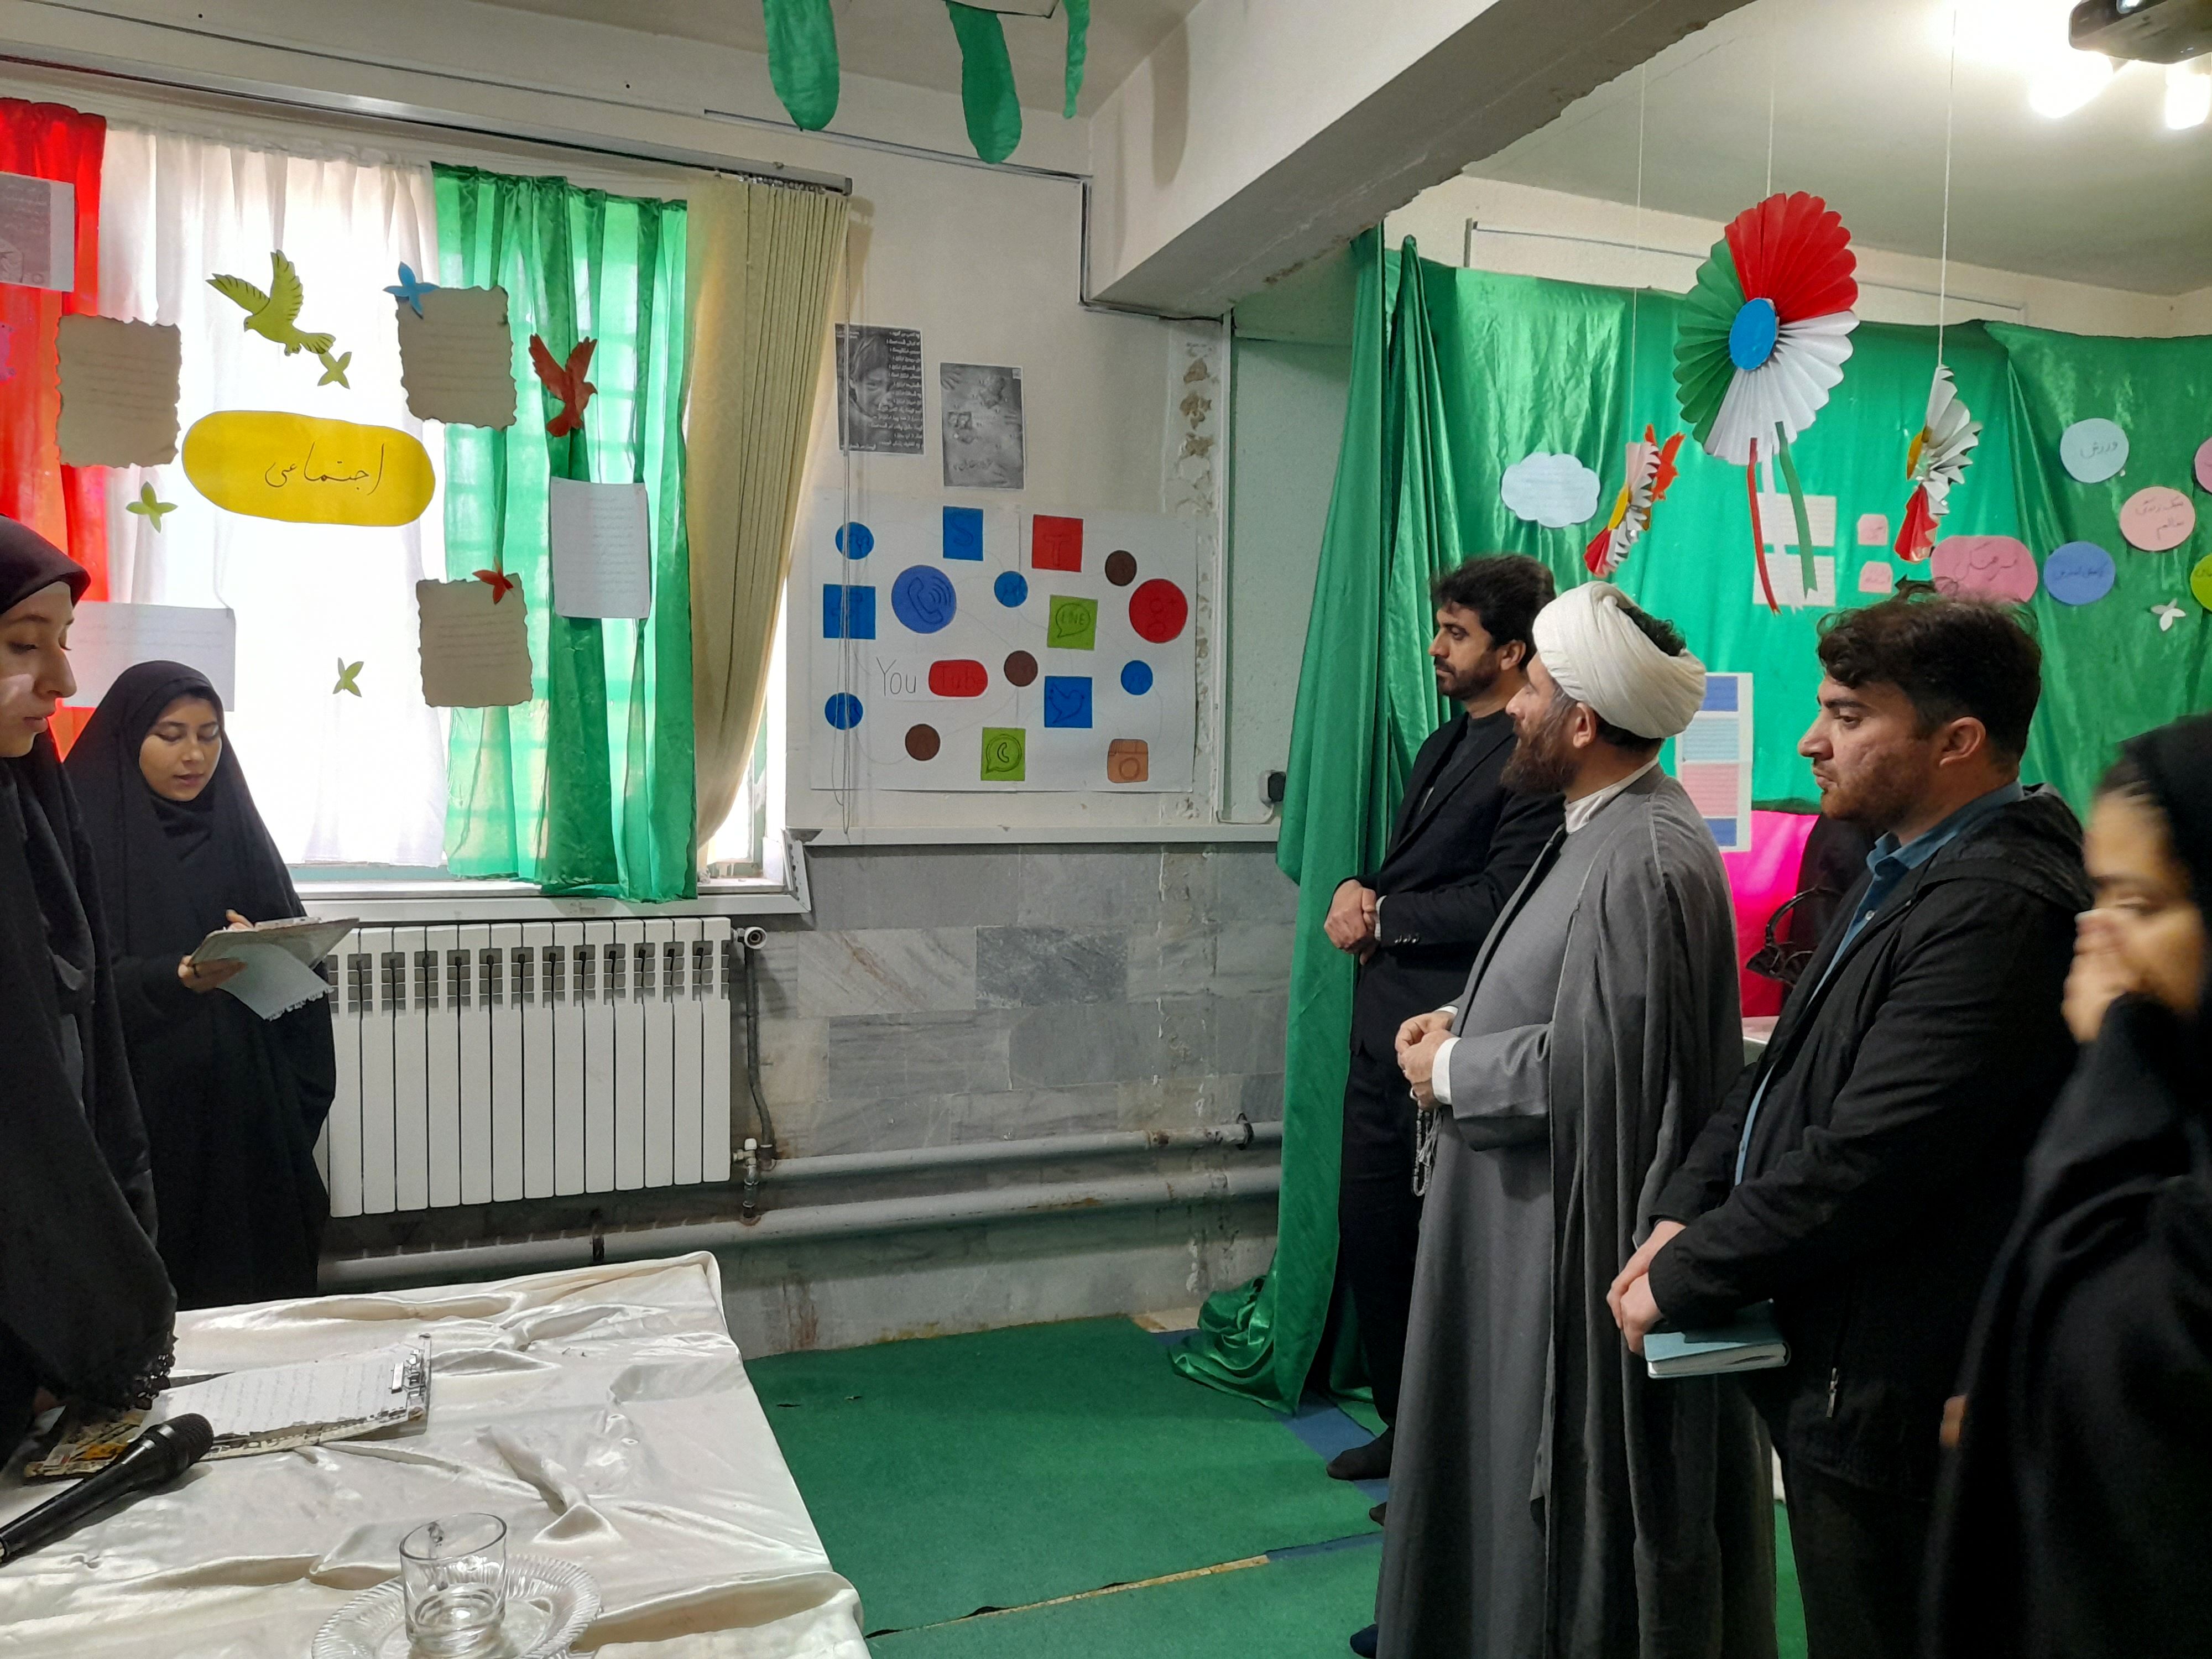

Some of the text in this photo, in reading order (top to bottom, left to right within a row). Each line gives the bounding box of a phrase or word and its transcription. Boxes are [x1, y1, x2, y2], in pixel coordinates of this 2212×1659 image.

[2079, 441, 2119, 460] ورزش
[265, 441, 384, 495] اجتماعی
[2156, 517, 2185, 541] سالم
[1043, 533, 1072, 567] T
[1060, 609, 1086, 626] LINE
[876, 656, 917, 697] You
